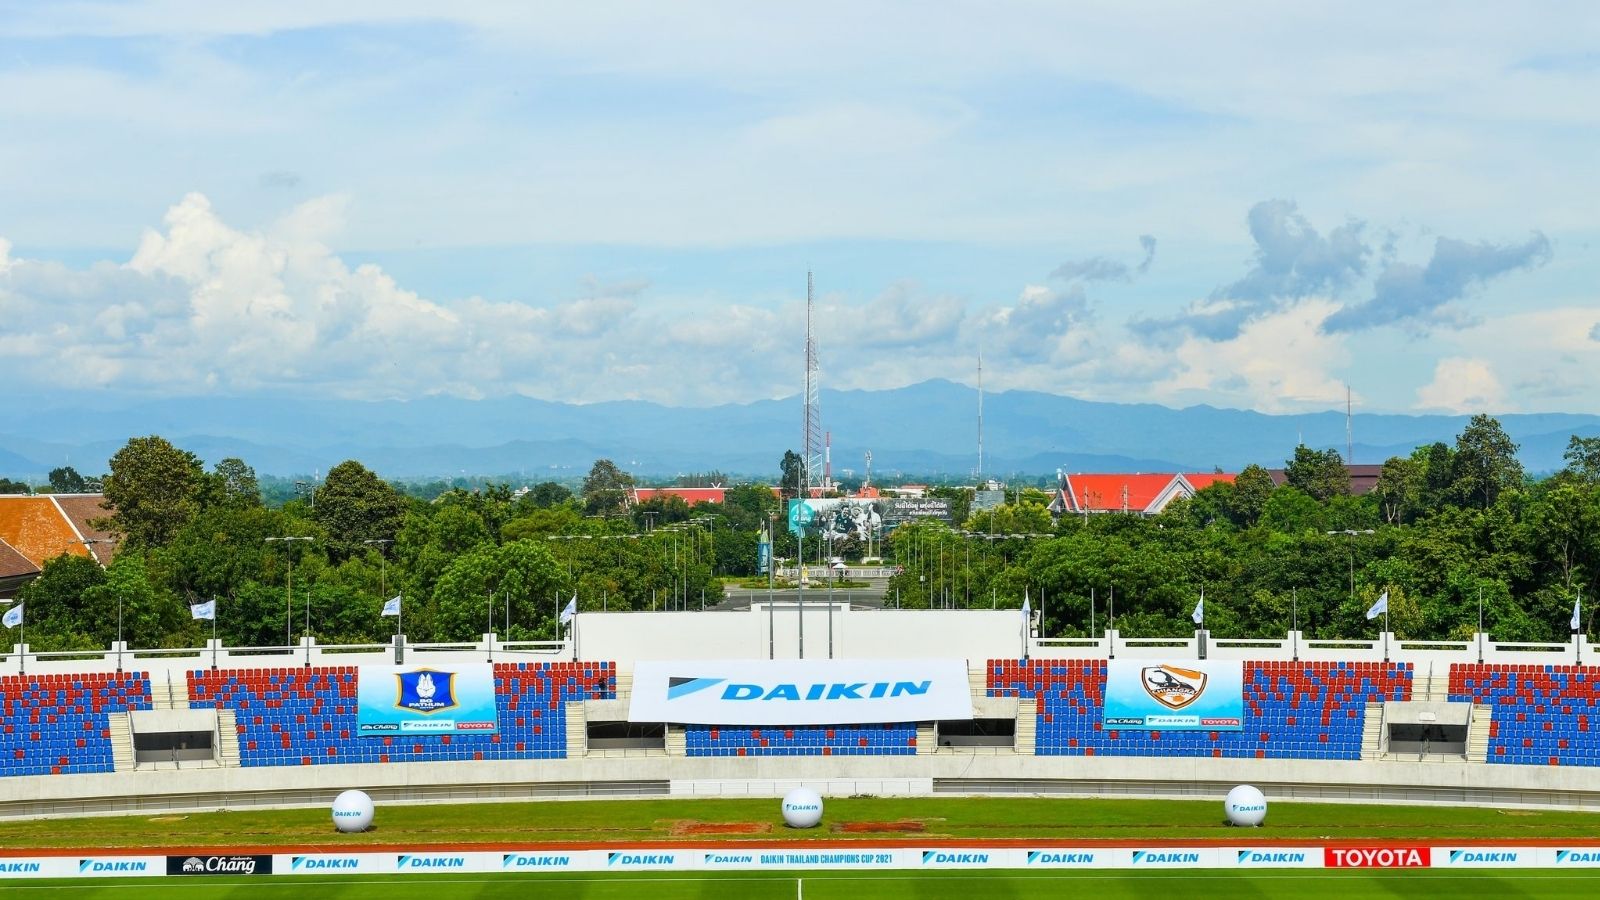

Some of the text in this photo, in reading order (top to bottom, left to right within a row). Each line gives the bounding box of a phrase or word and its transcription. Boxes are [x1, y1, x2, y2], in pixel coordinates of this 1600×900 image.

[720, 680, 933, 701] DAIKIN
[516, 857, 569, 866] DAIKIN
[621, 855, 674, 865] DAIKIN
[760, 854, 892, 864] DAIKIN THAILAND CHAMPIONS CUP 2021
[936, 854, 989, 863] DAIKIN
[1040, 854, 1093, 863] DAIKIN
[1146, 853, 1199, 863] DAIKIN
[1251, 853, 1304, 862] DAIKIN
[1332, 849, 1423, 866] TOYOTA
[1463, 853, 1517, 862] DAIKIN
[93, 862, 146, 871] DAIKIN
[206, 856, 256, 874] Chang
[305, 859, 358, 869] DAIKIN
[411, 858, 464, 867] DAIKIN
[0, 863, 40, 872] AIKIN
